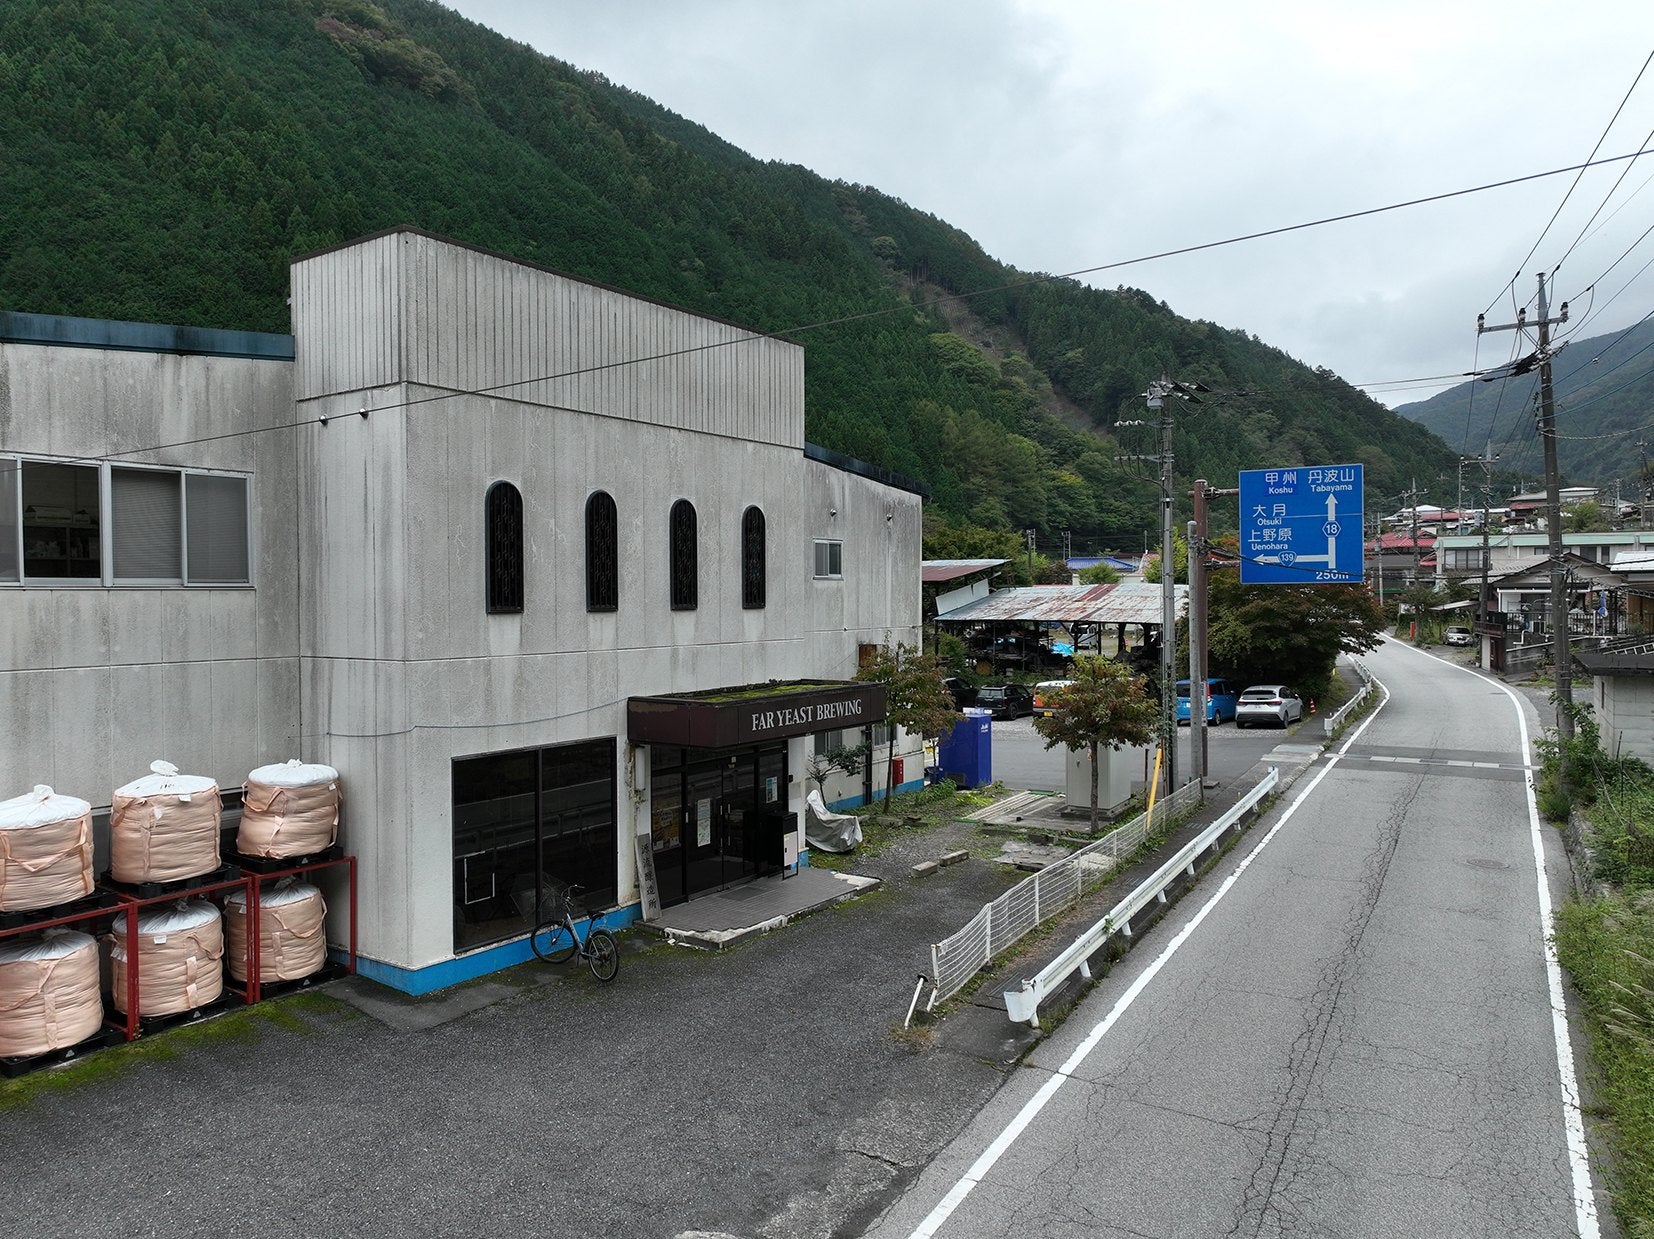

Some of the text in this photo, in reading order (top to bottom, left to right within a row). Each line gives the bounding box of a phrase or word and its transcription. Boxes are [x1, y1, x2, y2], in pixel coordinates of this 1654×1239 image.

[1265, 471, 1297, 485] 甲州
[1308, 468, 1355, 484] 丹波山
[1310, 484, 1353, 493] Tabayama
[1253, 503, 1286, 517] 大月
[1257, 518, 1282, 526] Otsuki
[1325, 524, 1338, 534] 18
[1247, 527, 1293, 542] 上野原
[1251, 543, 1289, 551] Uenohara
[1280, 553, 1294, 561] 139
[1315, 570, 1349, 580] 250m
[752, 699, 862, 731] FAR YEAST BREWING
